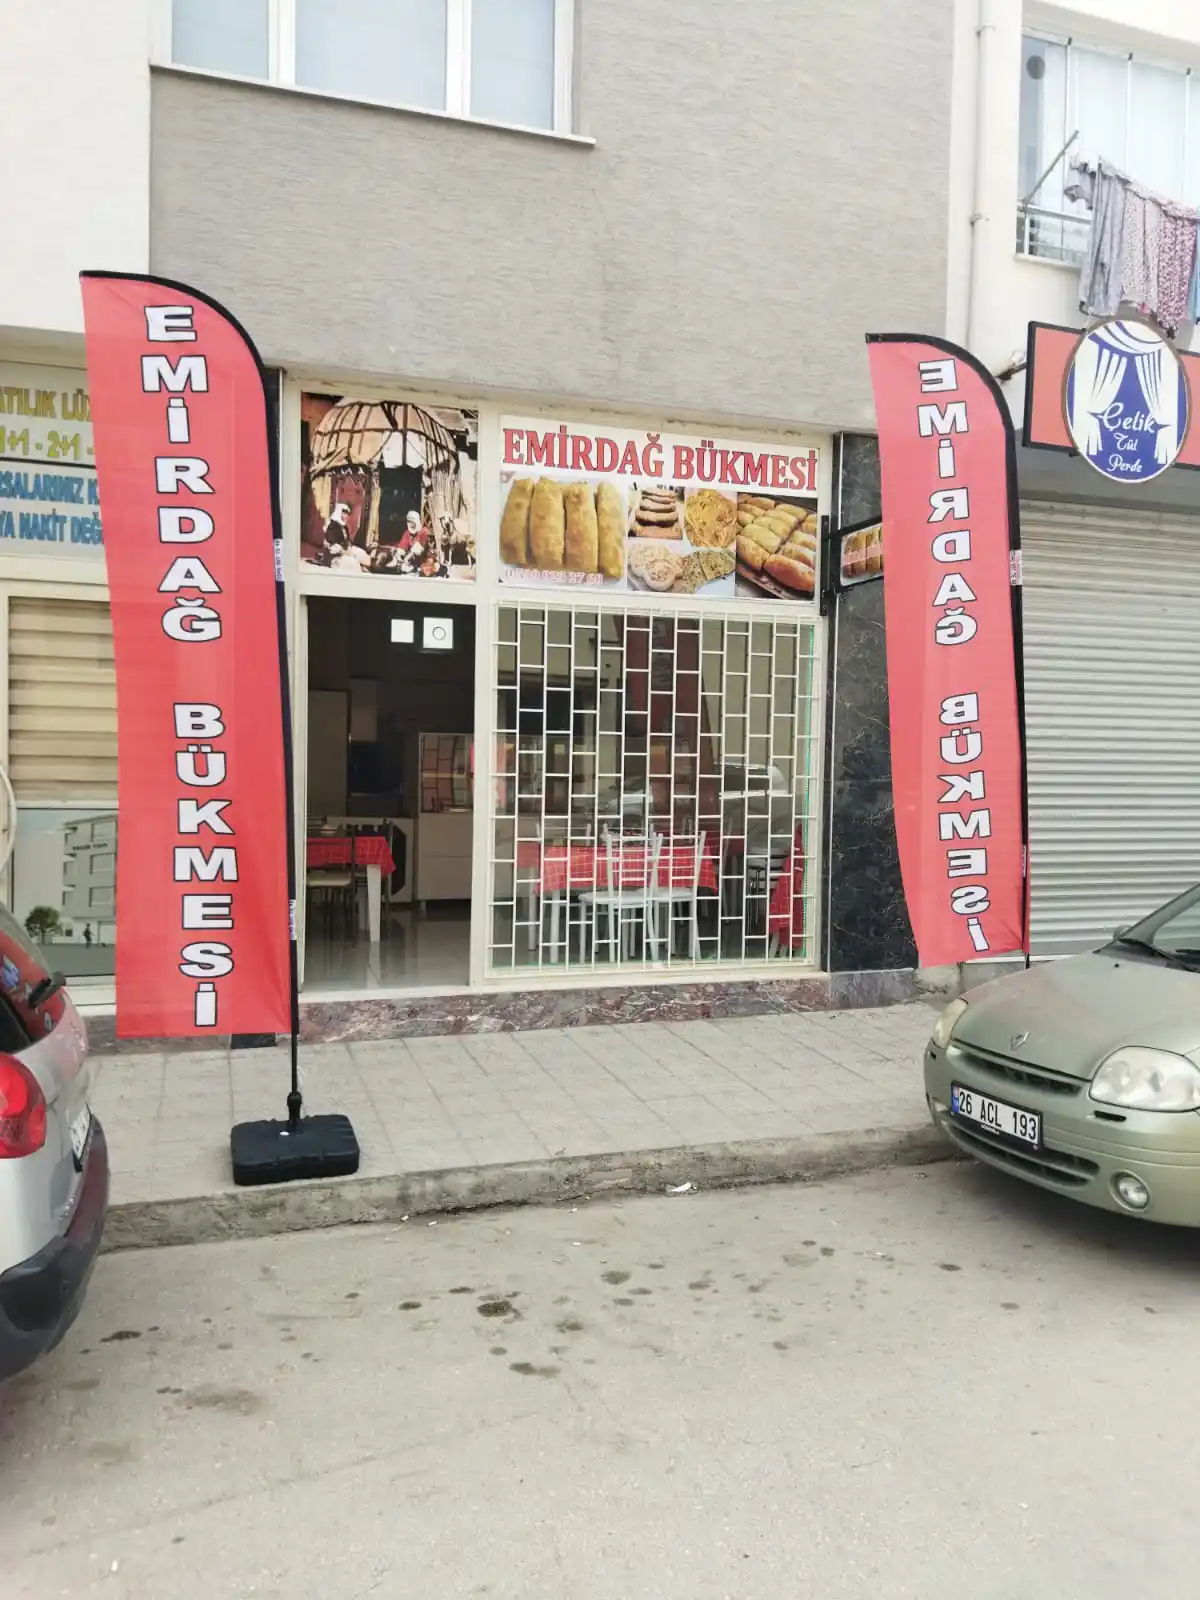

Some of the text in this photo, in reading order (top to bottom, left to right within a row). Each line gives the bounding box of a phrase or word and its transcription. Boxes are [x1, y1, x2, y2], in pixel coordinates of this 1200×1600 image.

[1096, 402, 1155, 434] Çelik
[503, 424, 818, 491] EMİRDAĞ BÜKMESİ
[1106, 453, 1143, 473] Perde
[20, 508, 67, 542] NAKİT
[141, 305, 239, 1027] EMİRDAĞ BÜKMESİ
[959, 1091, 972, 1115] 26
[981, 1099, 1002, 1128] ACL
[1012, 1111, 1037, 1140] 193
